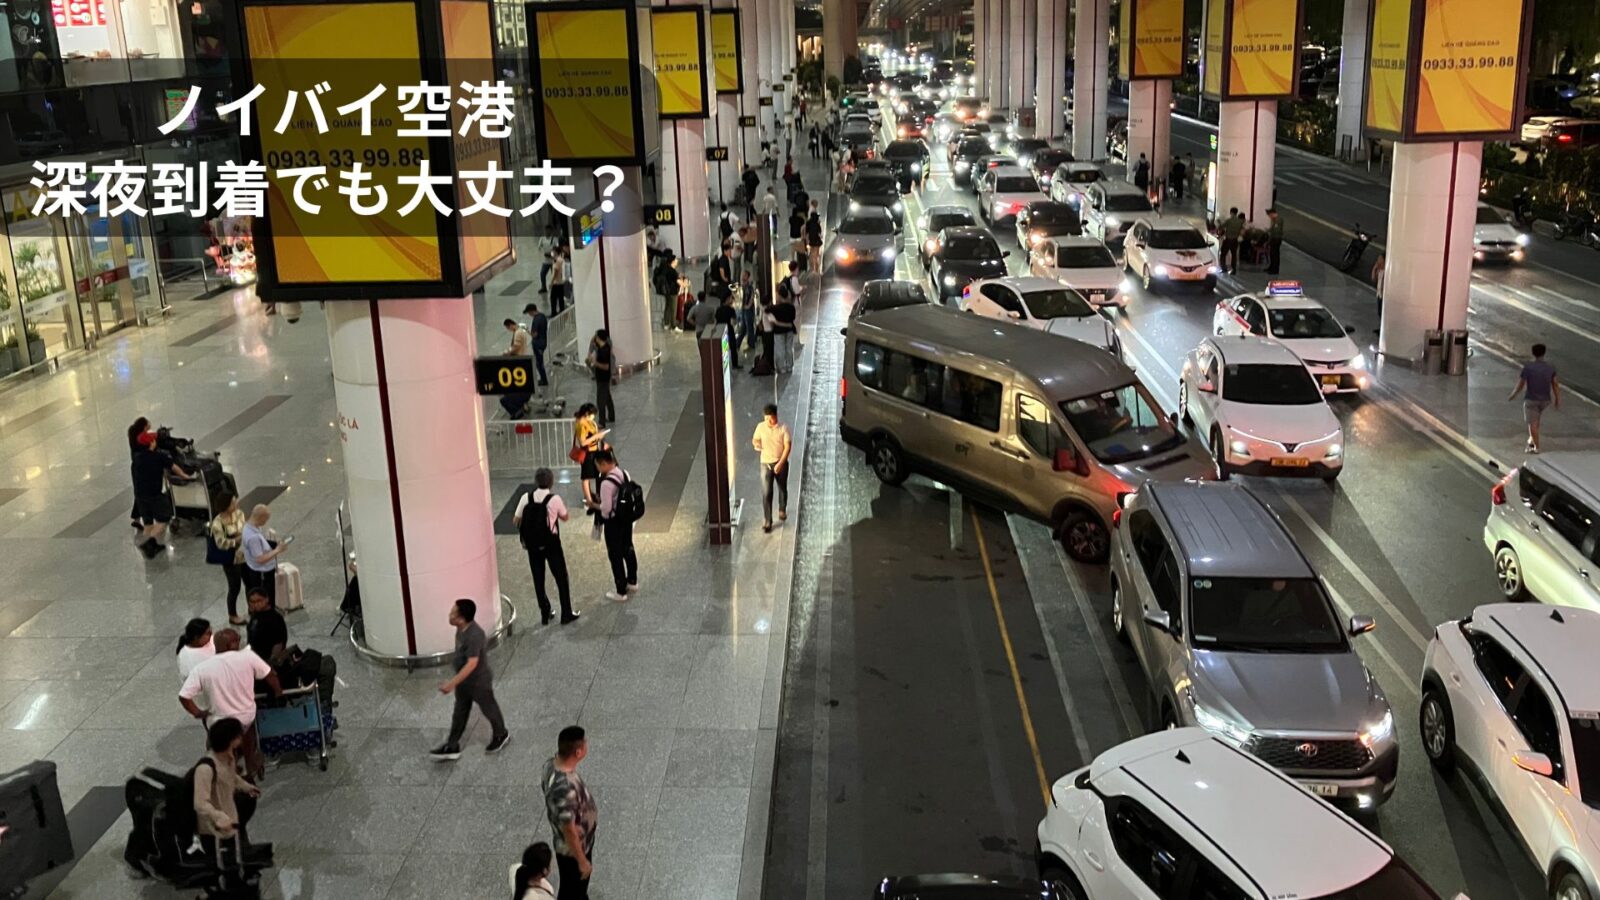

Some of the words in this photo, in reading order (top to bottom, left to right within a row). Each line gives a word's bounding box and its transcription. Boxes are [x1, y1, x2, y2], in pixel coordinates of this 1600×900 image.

[1424, 56, 1514, 71] 0933.33.99.88
[267, 148, 425, 170] 0933.3399.88
[714, 149, 726, 159] 07
[655, 208, 672, 222] 08
[498, 367, 527, 387] 09
